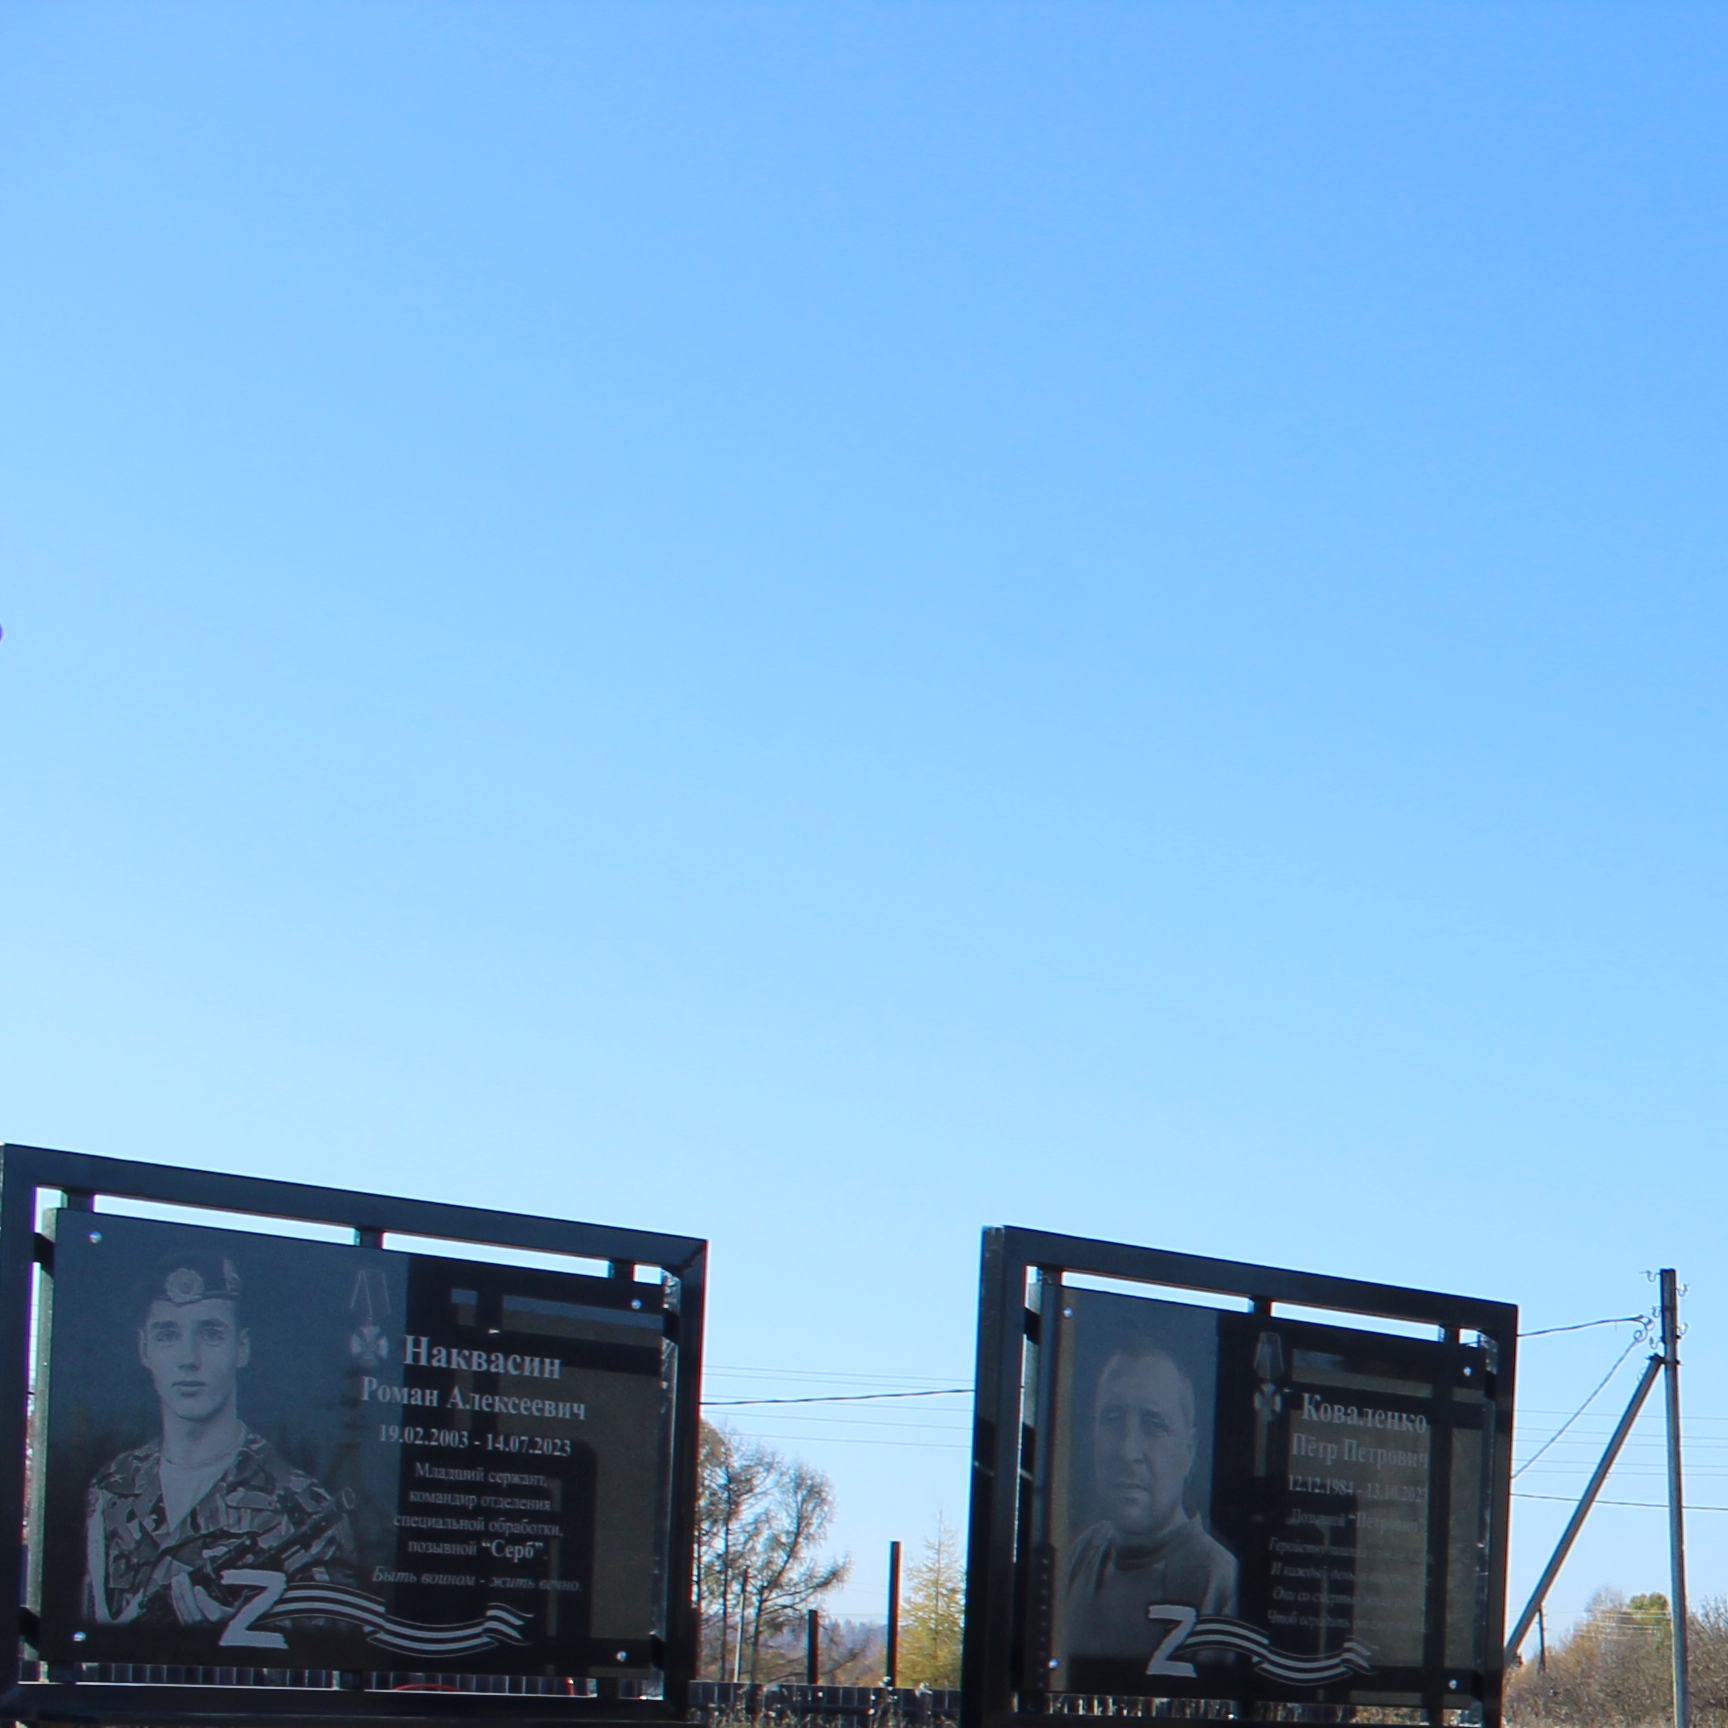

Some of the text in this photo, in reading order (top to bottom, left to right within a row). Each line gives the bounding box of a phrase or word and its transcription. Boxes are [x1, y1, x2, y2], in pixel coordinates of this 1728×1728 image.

[402, 1334, 562, 1380] Наквасин
[360, 1376, 587, 1421] Роман Алексеевич
[1301, 1392, 1429, 1434] Коваленко
[378, 1423, 572, 1457] 19.02.2003 14.07.2023
[1291, 1432, 1429, 1471] Пётр Петрович
[415, 1462, 549, 1487] Младший сержант,
[1288, 1474, 1354, 1495] 12.12.1984
[409, 1490, 551, 1511] командир отделения
[392, 1513, 564, 1537] специальной обработки,
[408, 1539, 478, 1556] позывной
[371, 1565, 417, 1583] Быть
[421, 1571, 476, 1587] воином
[488, 1575, 535, 1589] жить
[218, 1569, 290, 1650] Z
[1146, 1603, 1198, 1679] Z
